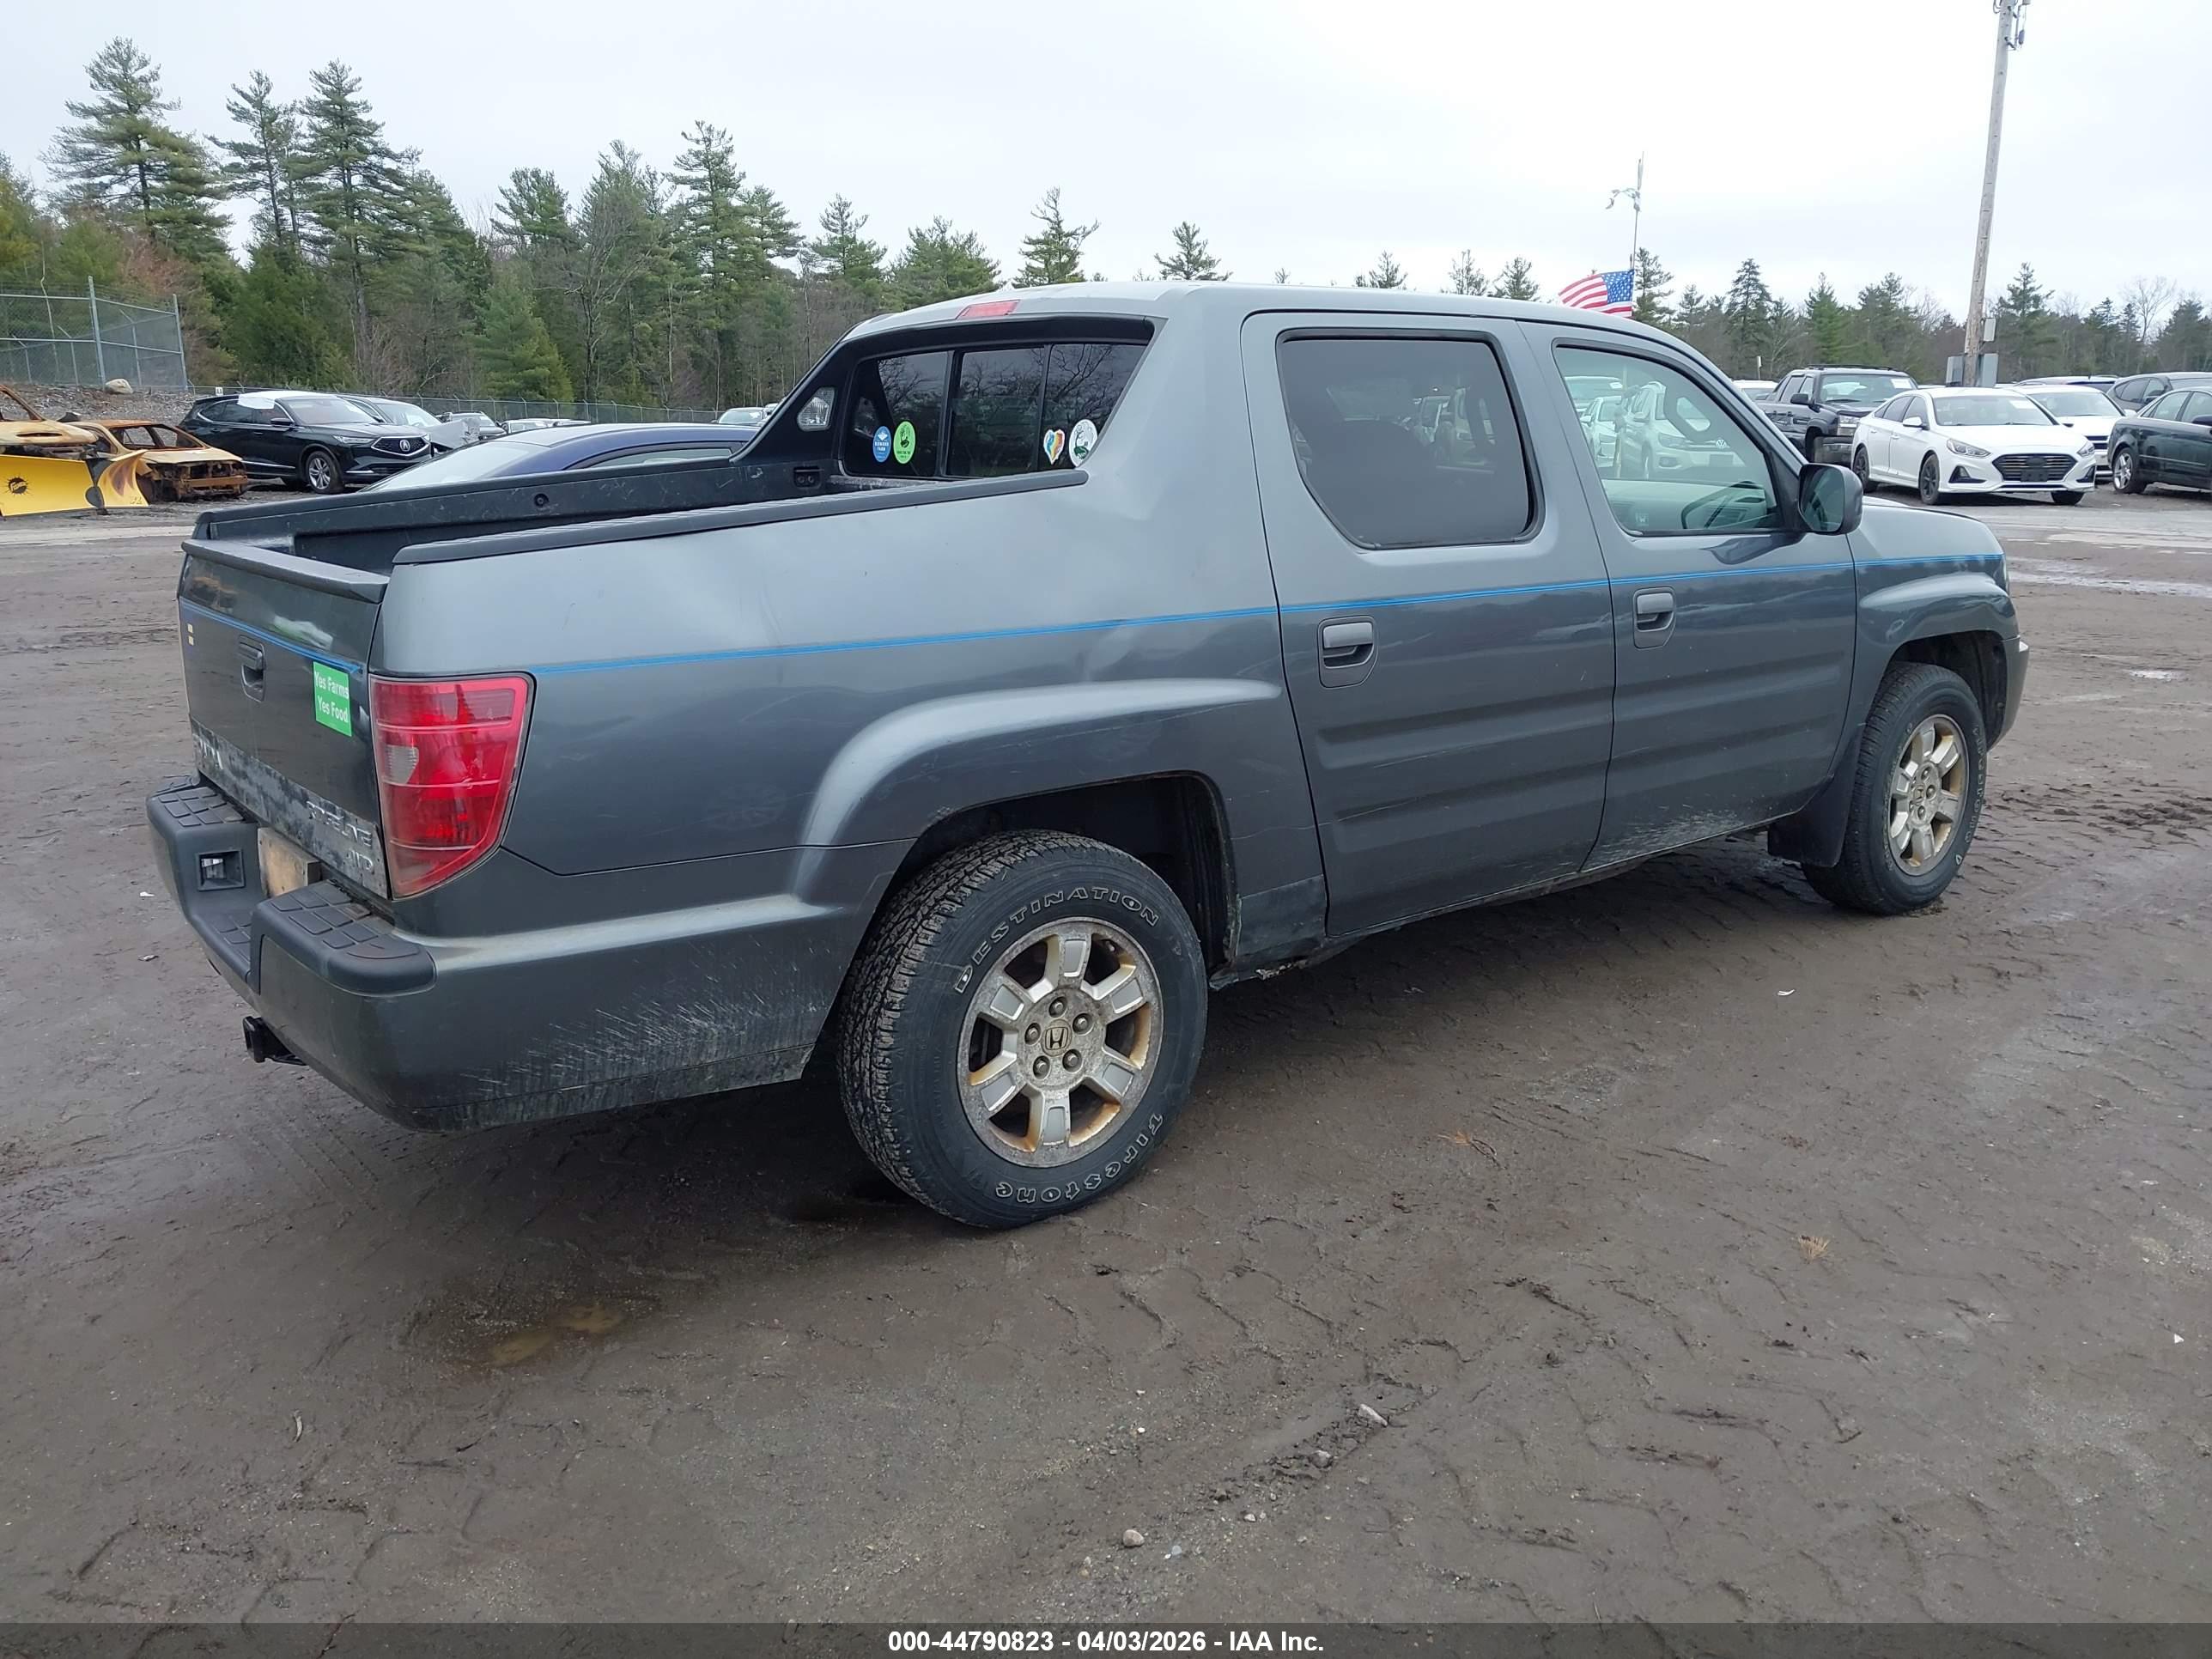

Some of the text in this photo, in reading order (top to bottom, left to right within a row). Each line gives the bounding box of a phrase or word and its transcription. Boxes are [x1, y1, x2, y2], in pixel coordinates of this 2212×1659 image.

[314, 671, 349, 699] Yes Farms
[317, 695, 349, 723] Yes Food
[954, 886, 1160, 994] DESTINATION
[995, 1111, 1164, 1204] Firestone
